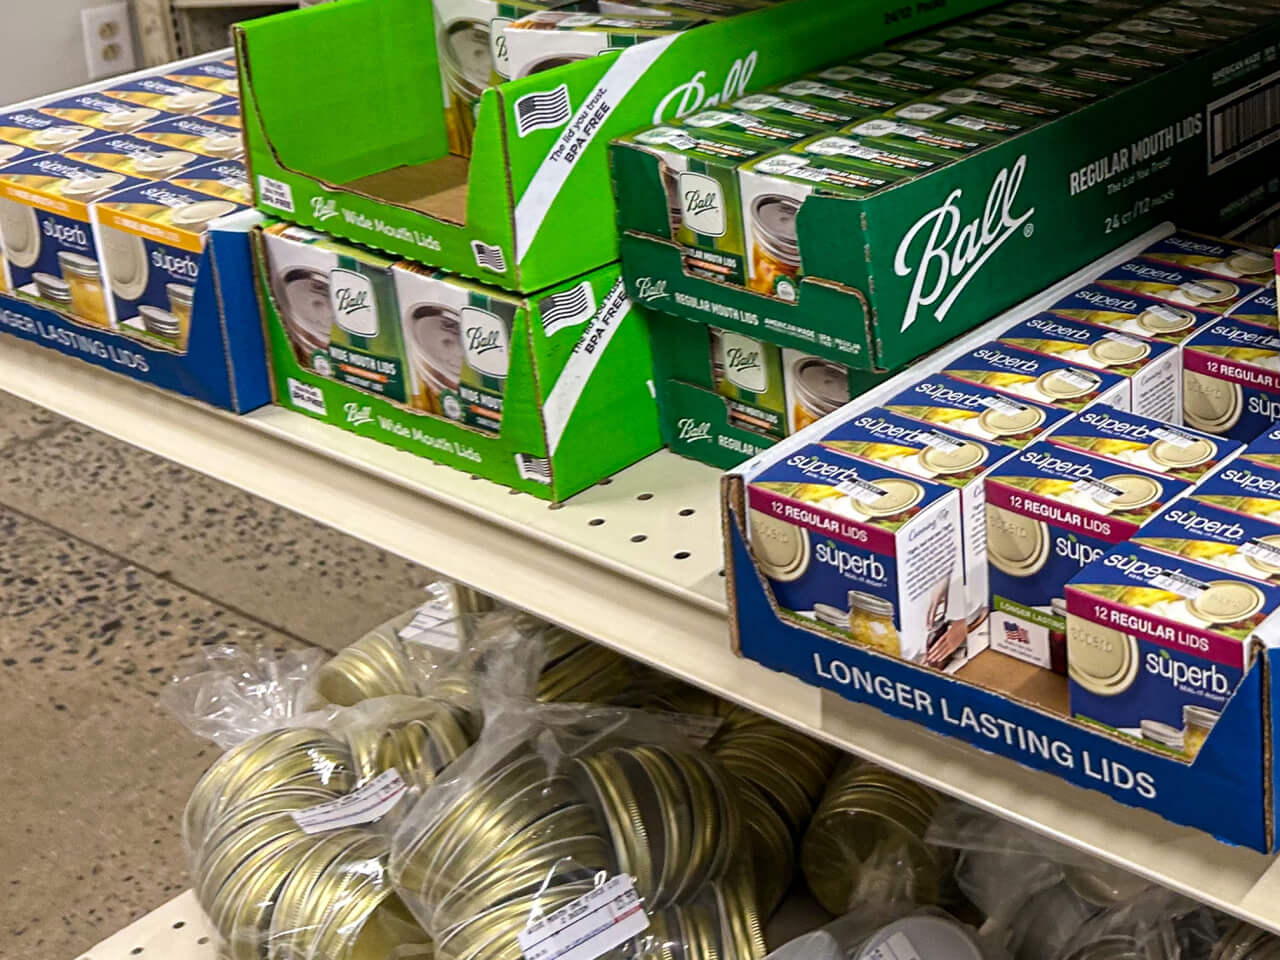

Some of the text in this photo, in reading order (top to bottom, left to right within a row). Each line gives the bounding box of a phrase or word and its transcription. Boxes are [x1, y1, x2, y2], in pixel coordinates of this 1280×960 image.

[549, 142, 566, 163] The
[563, 126, 576, 144] lid
[574, 110, 590, 132] you
[565, 102, 611, 164] BPA FREE
[1070, 112, 1202, 196] REGULAR MOUTH LIDS
[311, 197, 339, 221] Ball
[685, 189, 718, 216] Ball
[43, 218, 87, 246] superb
[342, 207, 373, 231] Wide
[416, 232, 442, 251] Lids
[1104, 215, 1120, 234] 24
[894, 154, 1035, 333] Ball
[1164, 236, 1224, 255] superb
[151, 248, 199, 278] superb
[1119, 260, 1184, 283] superb
[336, 288, 371, 315] Ball
[636, 277, 670, 302] Ball
[1075, 288, 1138, 312] superb
[674, 292, 760, 326] REGULAR MOUTH LIDS
[584, 293, 627, 355] BPA FREE
[1026, 316, 1091, 341] superb
[36, 320, 149, 373] LASTING LIDS
[466, 326, 503, 355] Ball
[727, 348, 761, 372] Ball
[973, 347, 1038, 373] superb
[1207, 361, 1273, 388] 12 REGULAR
[915, 381, 981, 409] superb
[344, 402, 376, 427] Ball
[1080, 412, 1149, 439] superb
[378, 415, 482, 463] Wide Mouth Lids
[678, 419, 713, 443] Ball
[787, 453, 860, 482] superb
[1020, 450, 1092, 478] superb
[771, 501, 868, 542] 12 REGULAR LIDS
[1009, 494, 1111, 536] 12 REGULAR LIDS
[1165, 507, 1244, 540] superb
[816, 542, 886, 581] superb
[1093, 605, 1209, 652] 12 REGULAR LIDS
[1146, 649, 1229, 694] superb
[814, 652, 1157, 800] LONGER LASTING LIDS
